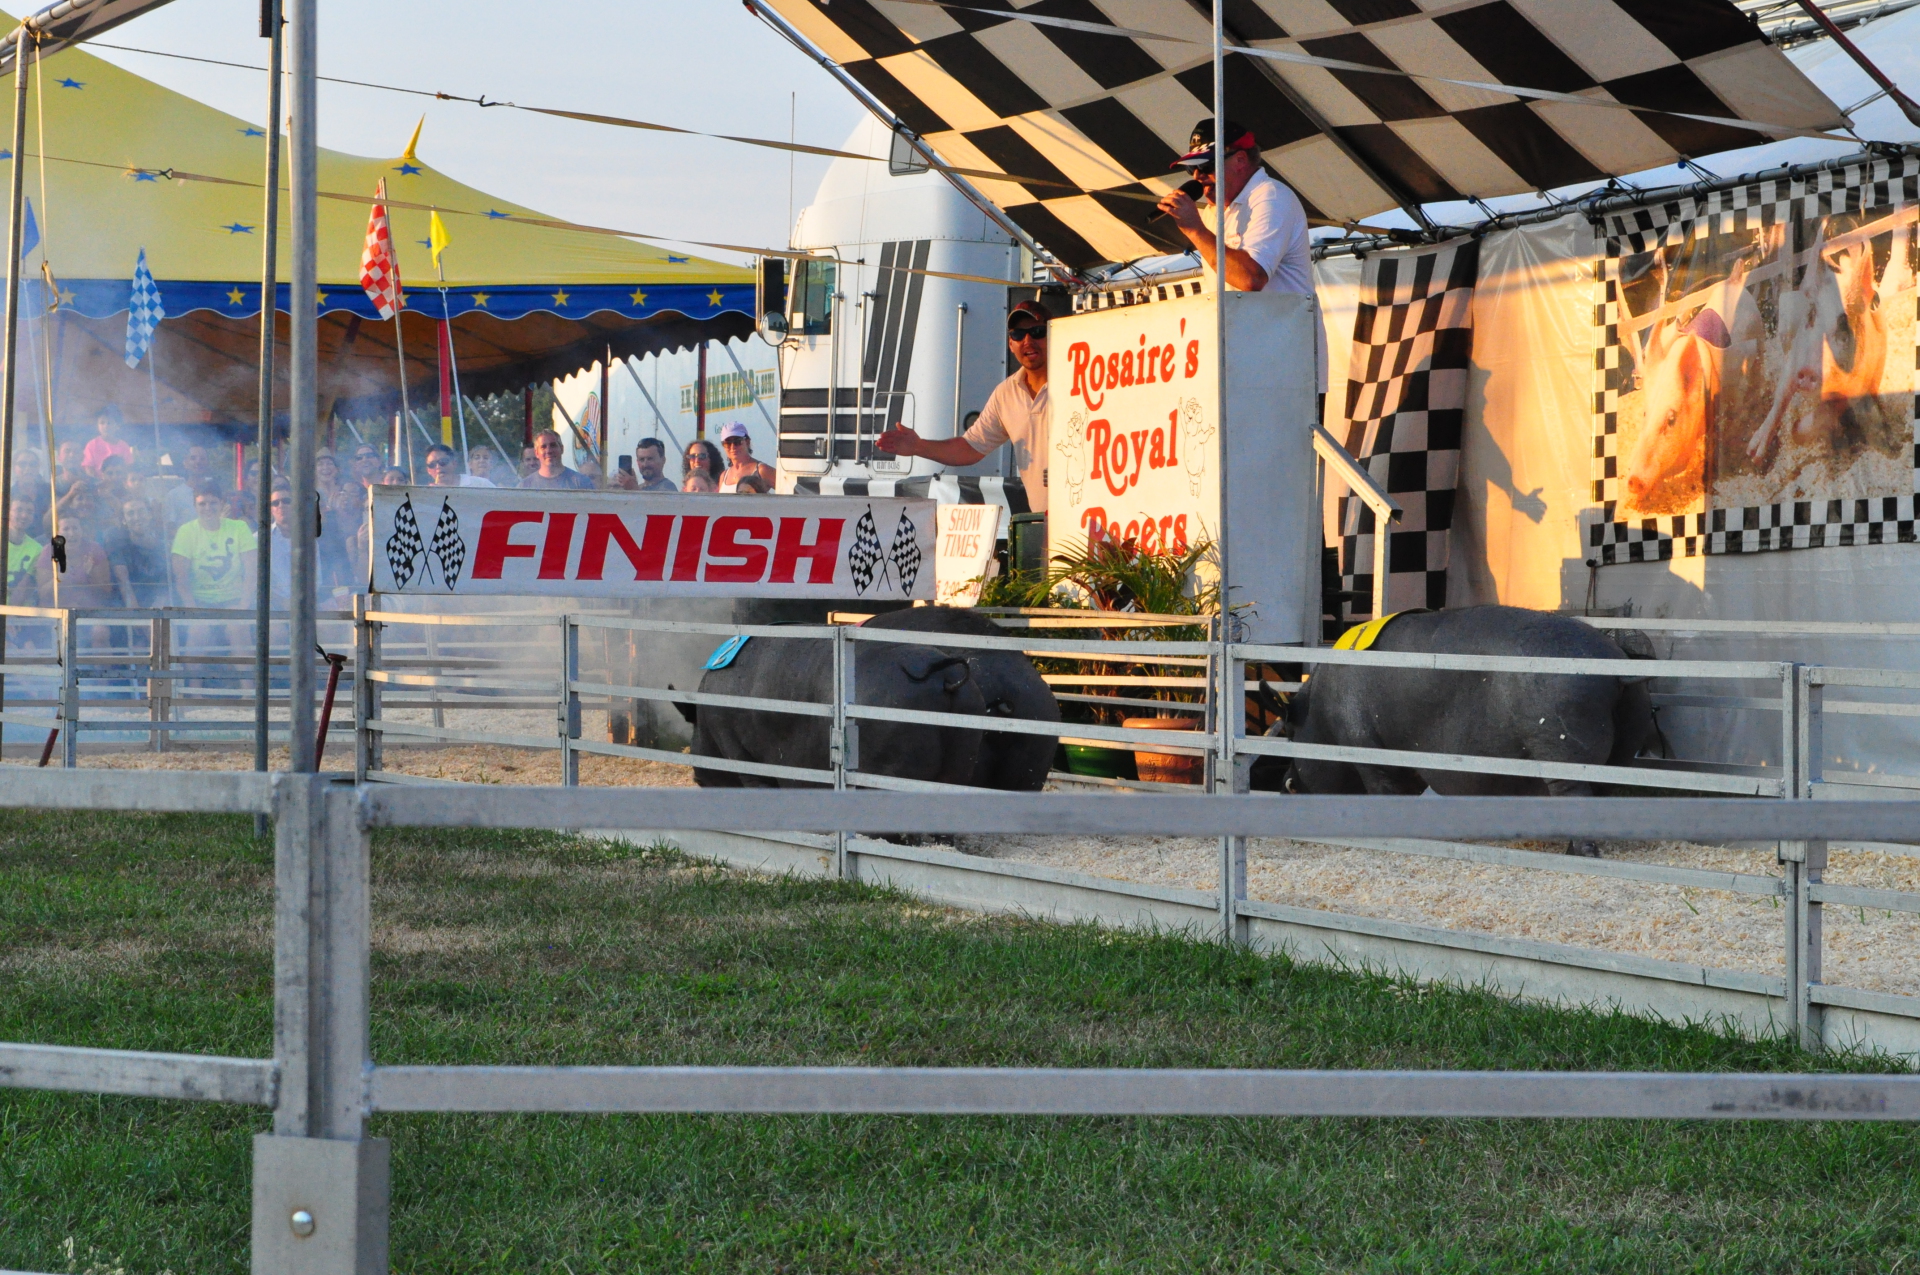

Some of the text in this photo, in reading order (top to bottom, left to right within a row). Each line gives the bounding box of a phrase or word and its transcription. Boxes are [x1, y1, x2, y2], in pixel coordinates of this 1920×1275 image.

[1067, 317, 1200, 412] Rosaire's
[1086, 408, 1179, 497] Royal
[471, 510, 847, 585] FINISH
[943, 533, 982, 559] TIMES
[948, 508, 985, 532] SHOW
